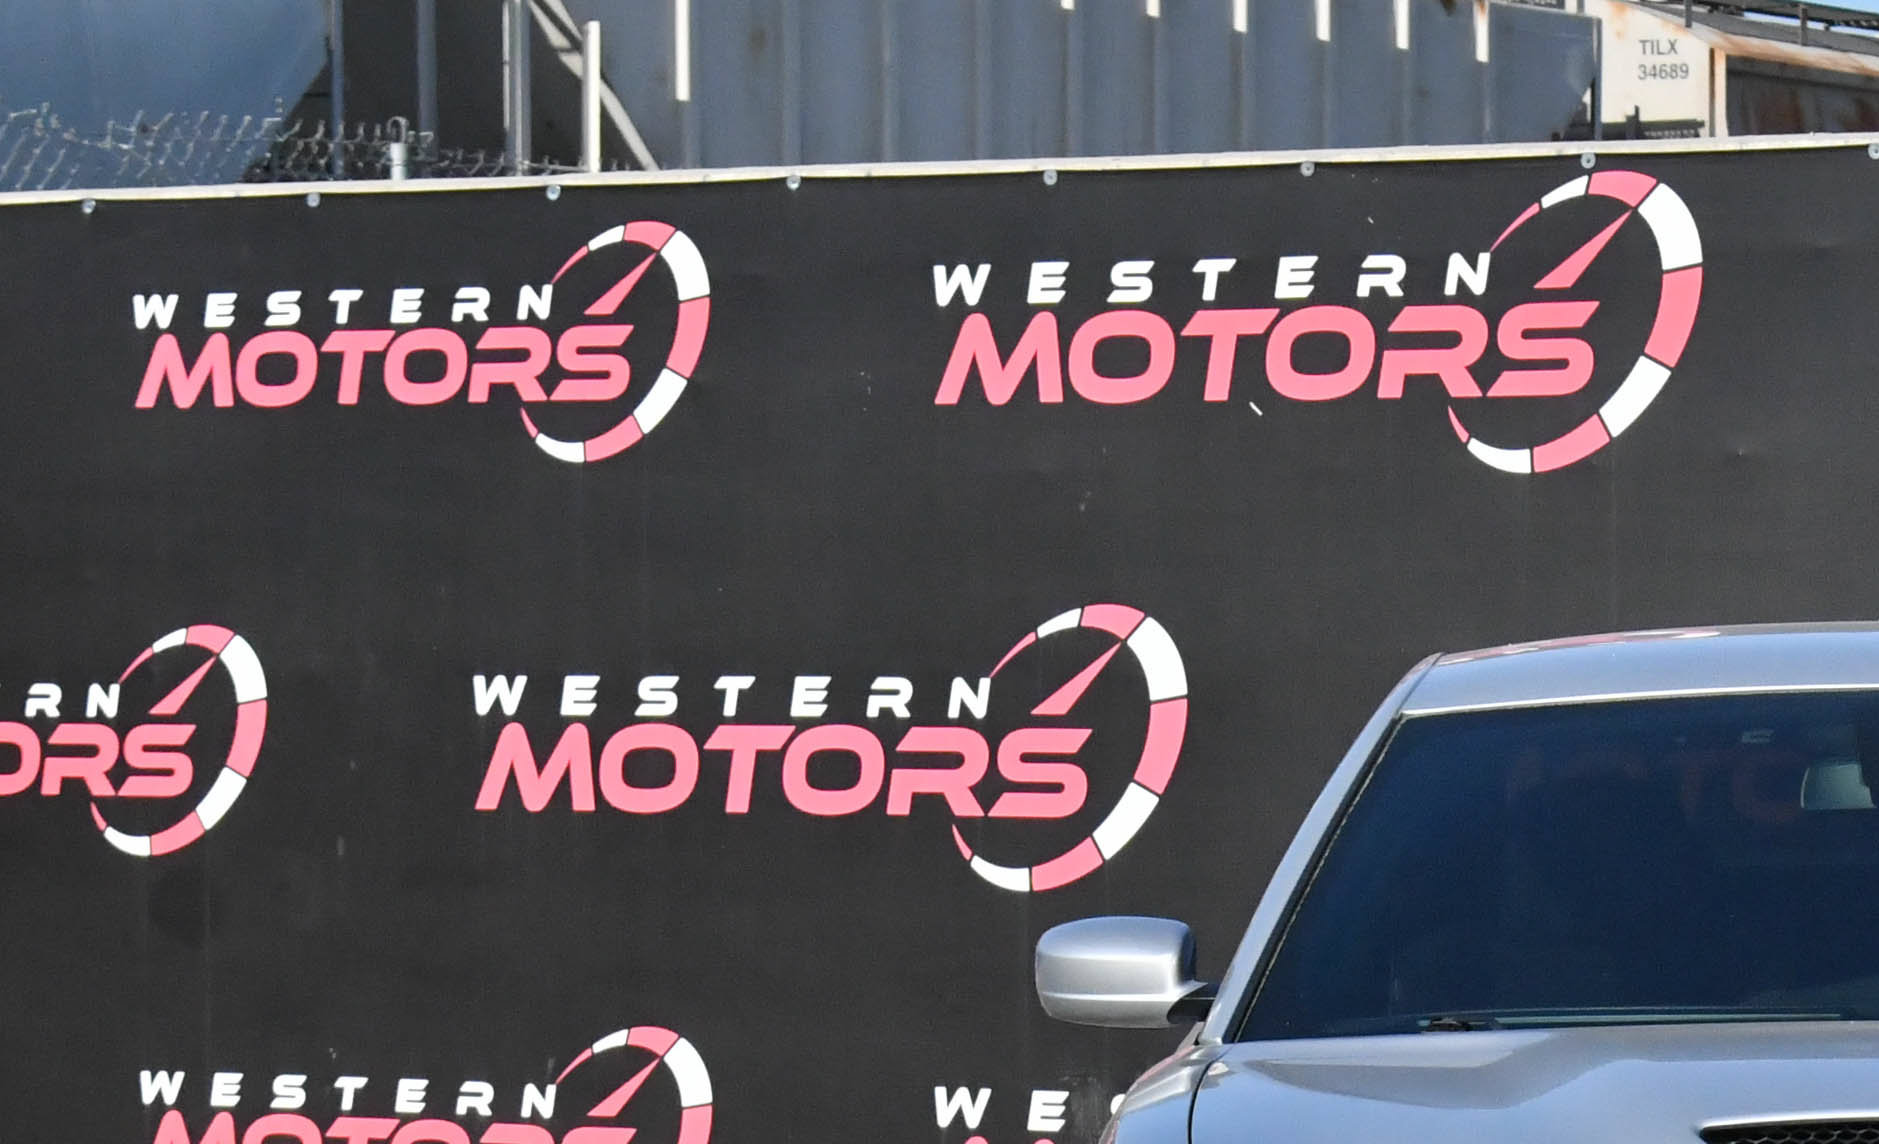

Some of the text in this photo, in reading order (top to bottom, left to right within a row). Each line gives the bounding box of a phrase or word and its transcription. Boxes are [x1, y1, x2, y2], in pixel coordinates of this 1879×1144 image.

[1637, 63, 1690, 80] 34689
[1639, 39, 1679, 56] TILX
[933, 251, 1491, 307] WESTERN
[132, 283, 553, 330] WESTERN
[135, 324, 635, 410] MOTORS
[934, 300, 1601, 407] MOTORS
[472, 674, 991, 720] WESTERN
[474, 721, 1093, 819] MOTORS
[139, 1070, 557, 1119] WESTERN
[934, 1086, 1125, 1133] WE
